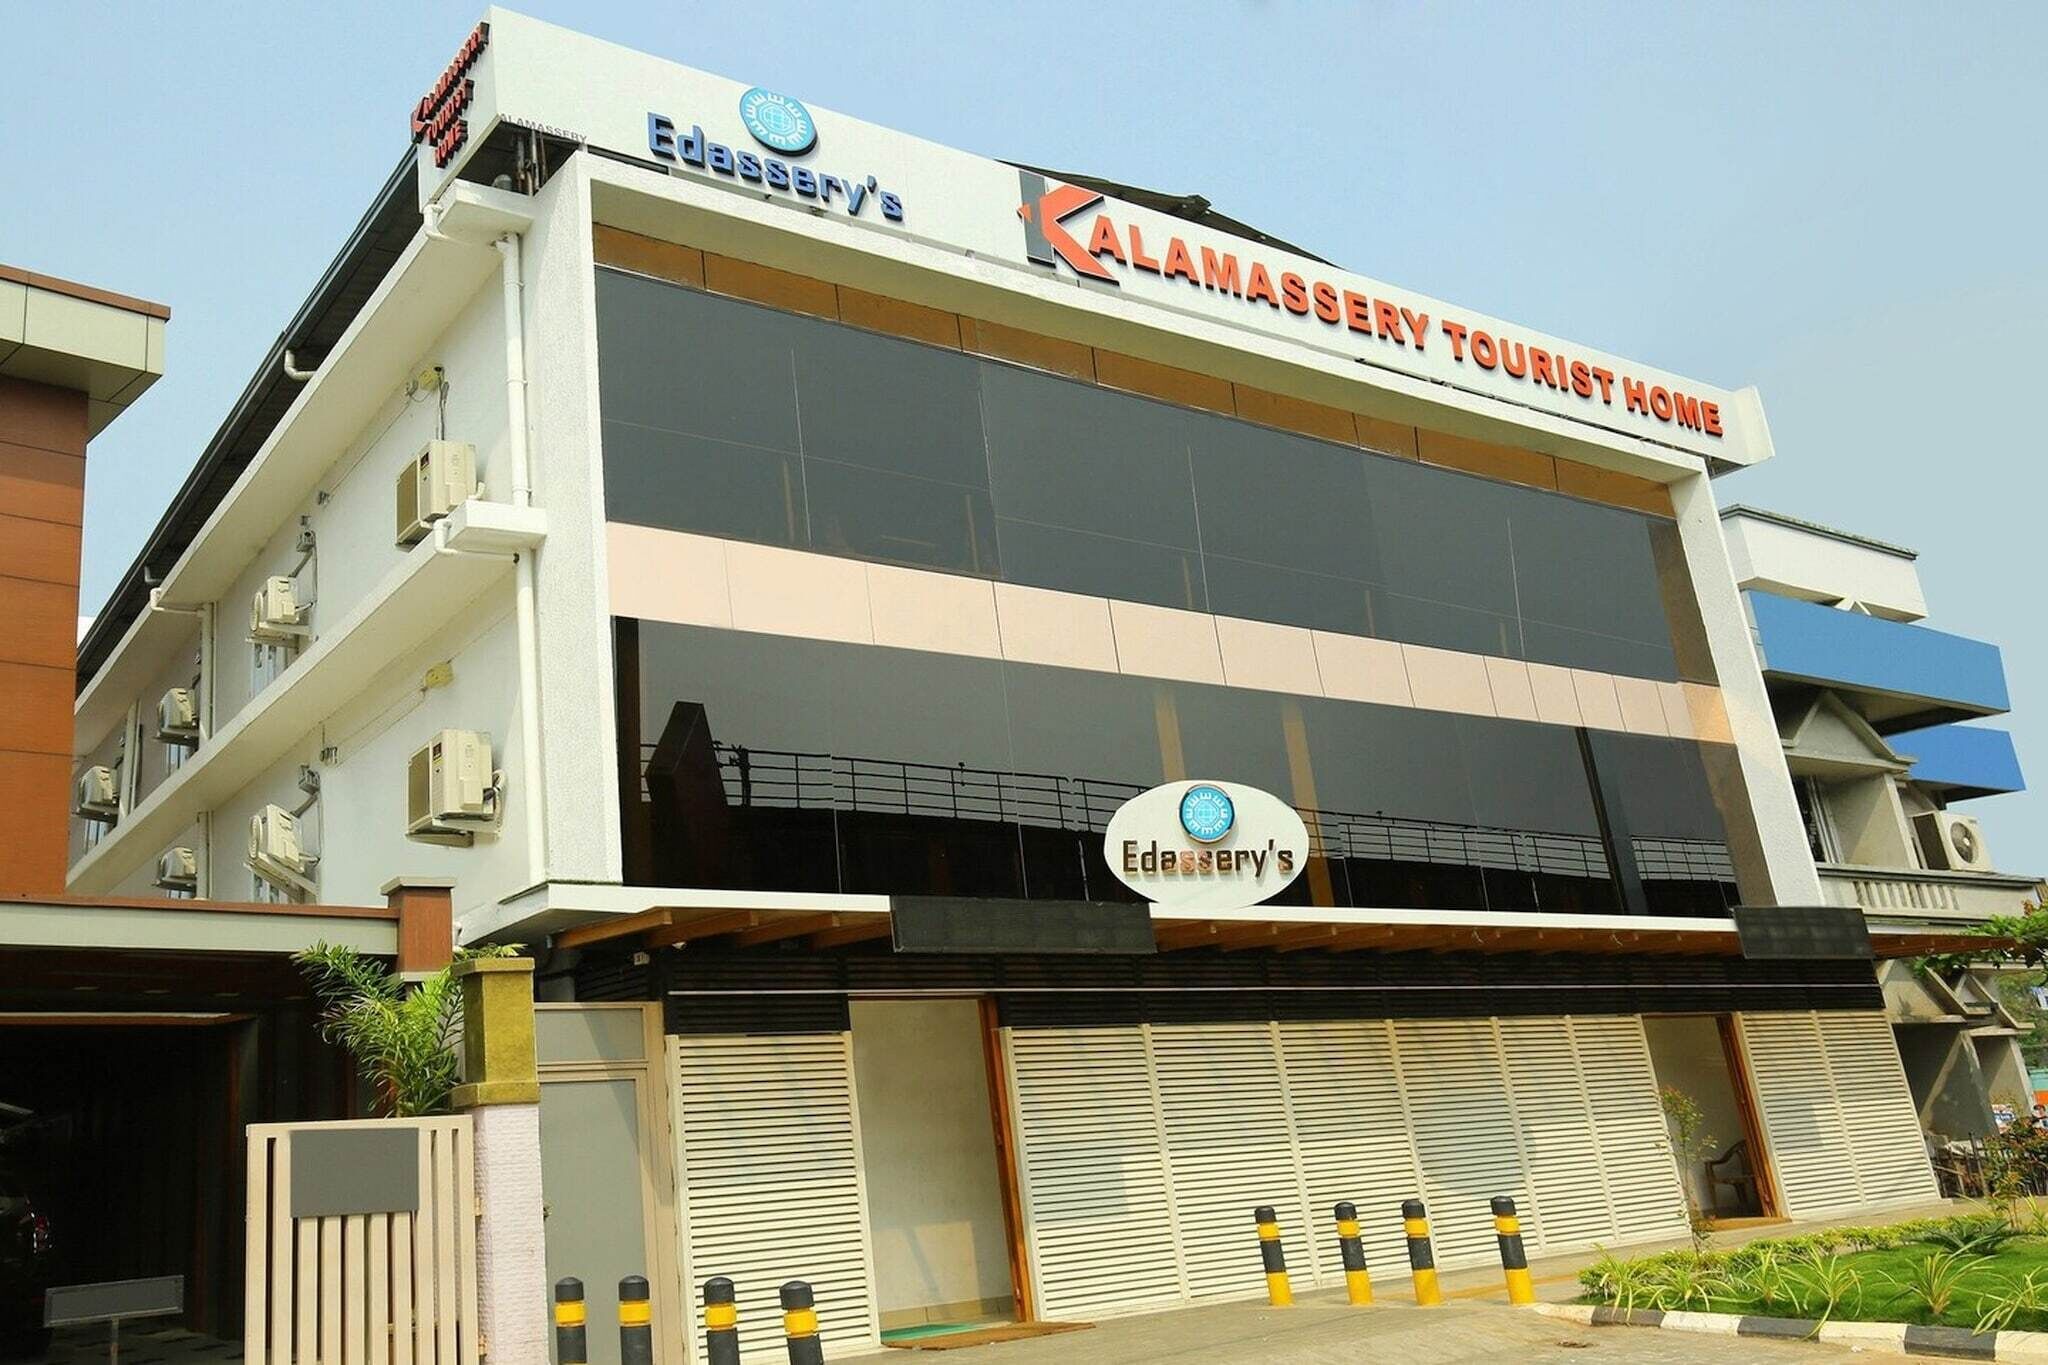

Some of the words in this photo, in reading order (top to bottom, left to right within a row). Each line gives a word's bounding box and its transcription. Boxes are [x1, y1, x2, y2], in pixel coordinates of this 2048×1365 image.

[647, 112, 904, 222] Edassery's
[1017, 169, 1430, 350] KALAMASSERY
[1441, 319, 1615, 405] TOURIST
[1622, 376, 1724, 438] HOME
[1121, 838, 1295, 879] Edassery's
